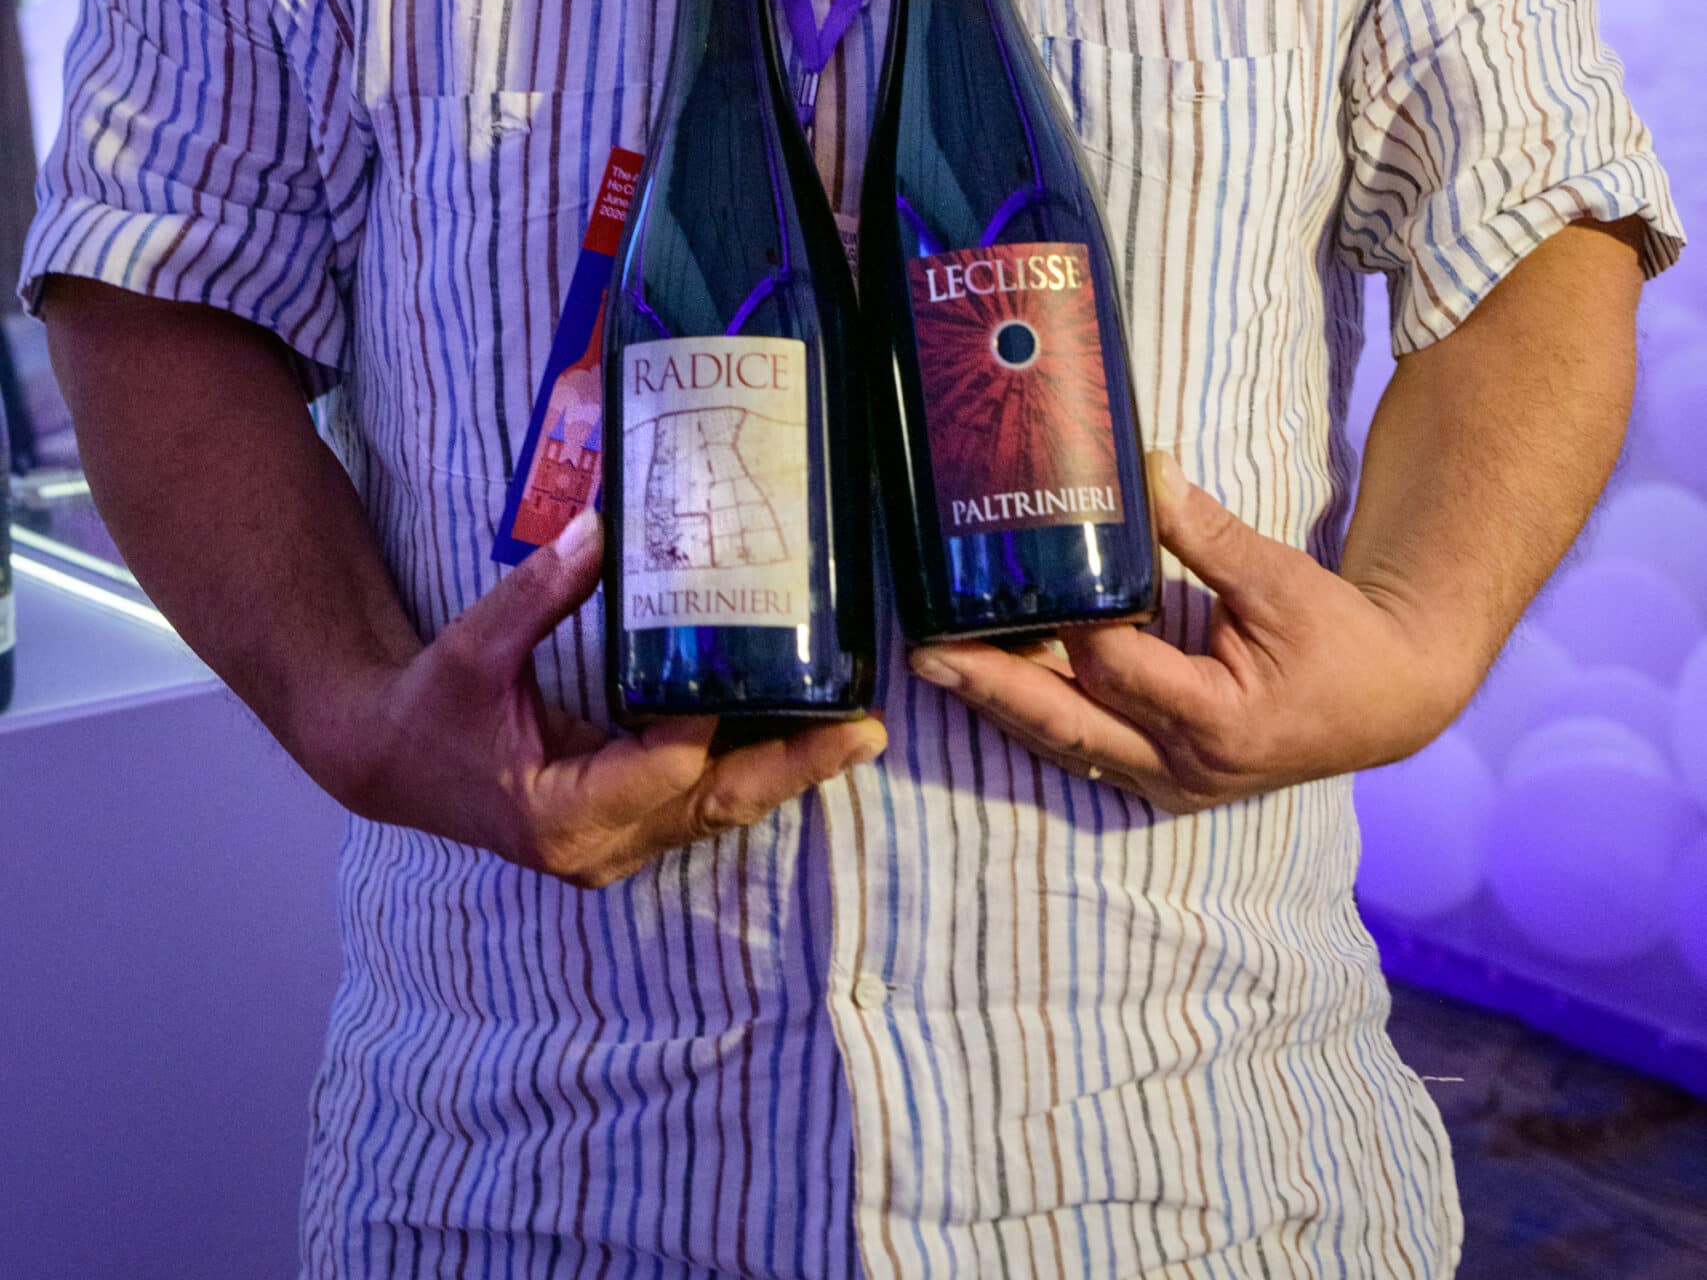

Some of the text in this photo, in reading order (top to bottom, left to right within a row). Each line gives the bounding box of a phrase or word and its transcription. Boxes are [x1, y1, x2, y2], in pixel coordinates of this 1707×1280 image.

[607, 179, 623, 192] Ho
[612, 165, 631, 180] The
[926, 254, 1082, 302] LECLISSE
[633, 352, 789, 395] RADICE
[951, 486, 1116, 526] PALTRINIERI
[631, 589, 792, 617] PALTRINIERI
